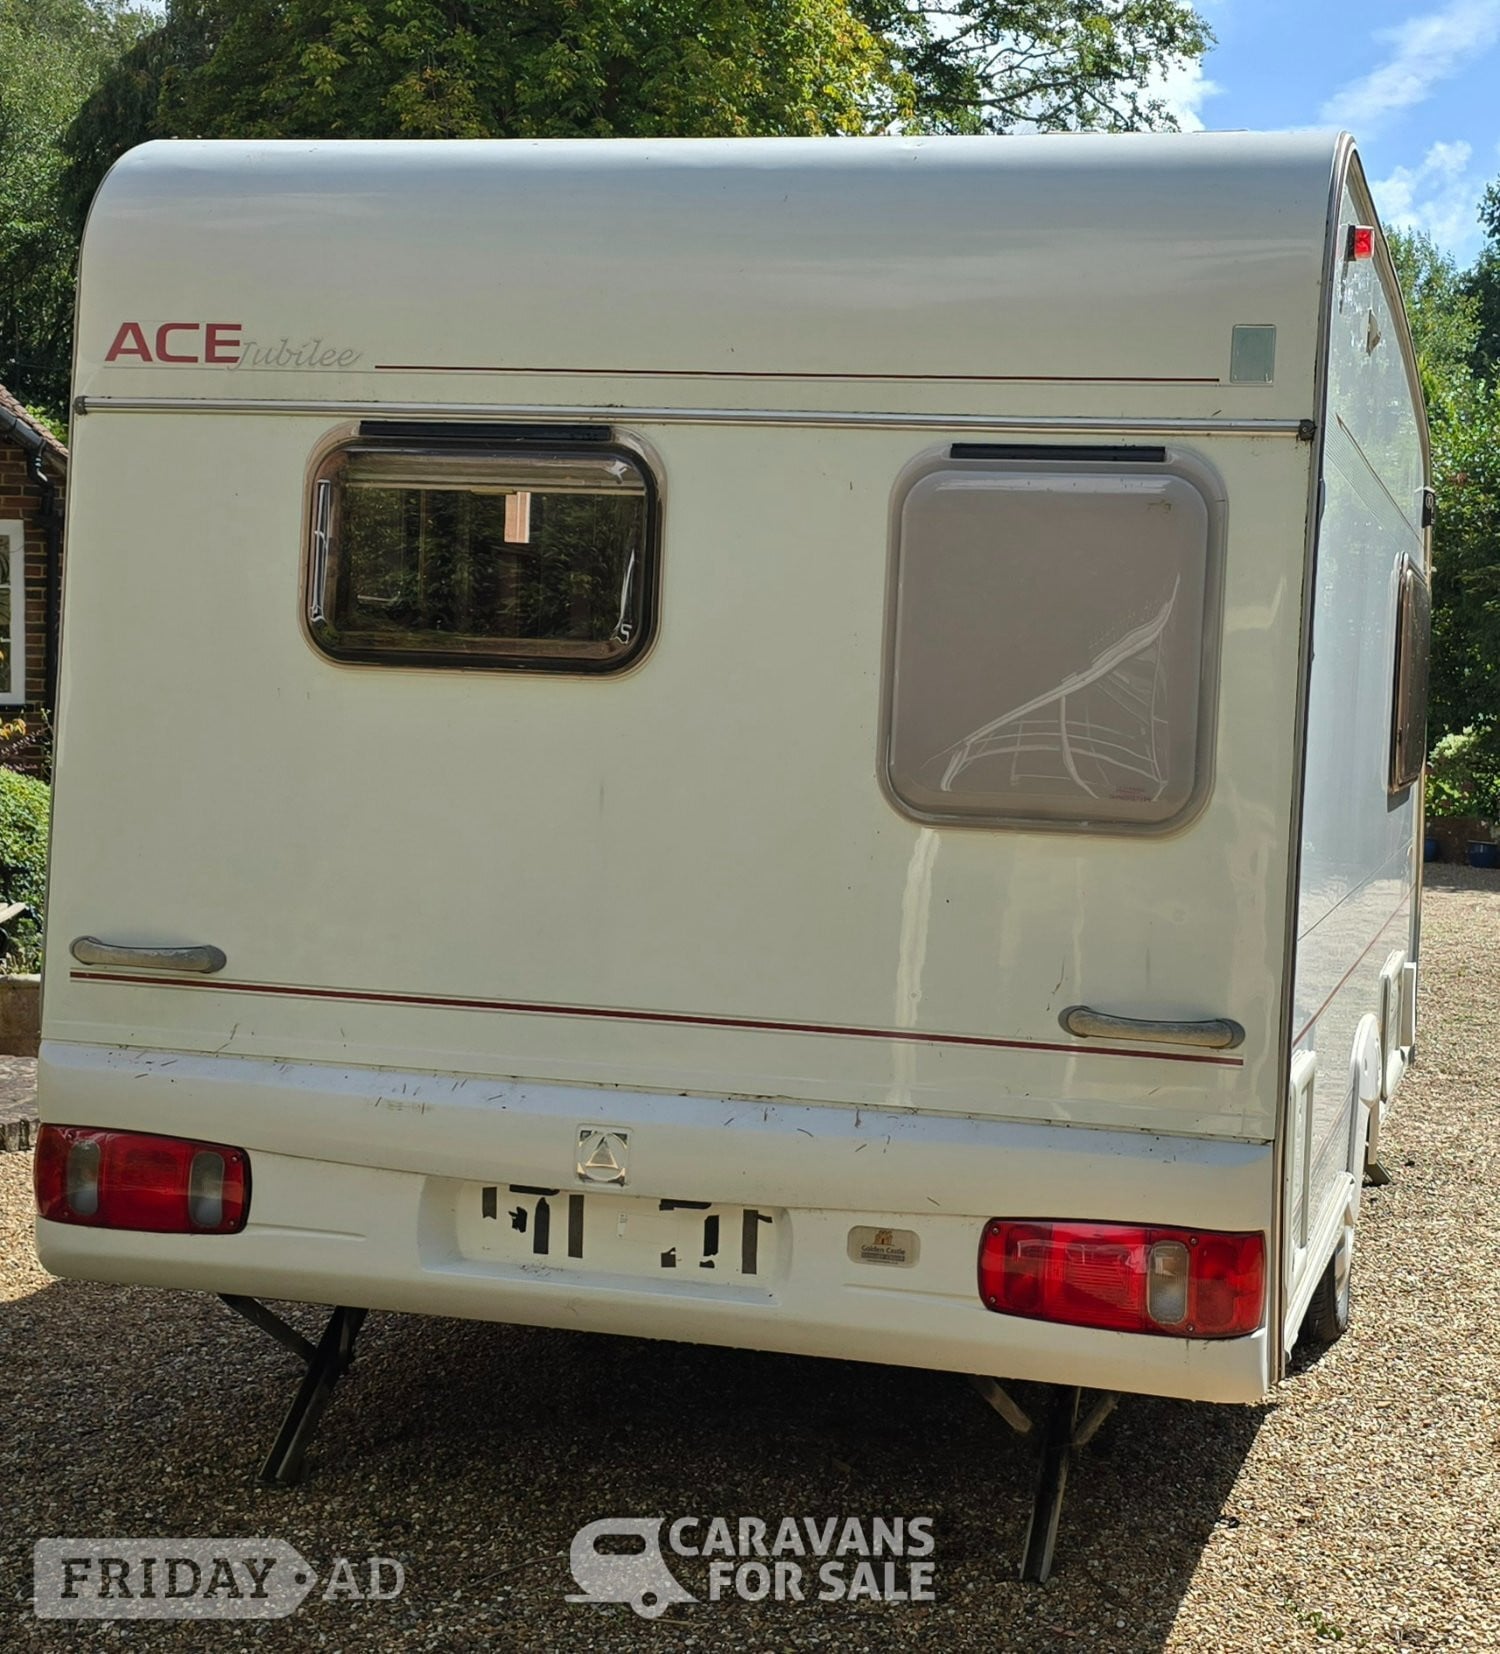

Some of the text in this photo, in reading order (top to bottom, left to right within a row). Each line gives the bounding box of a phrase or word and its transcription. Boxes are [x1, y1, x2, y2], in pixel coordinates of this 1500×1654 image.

[104, 322, 362, 371] ACE Jubilee
[860, 1244, 906, 1255] Golden Castle
